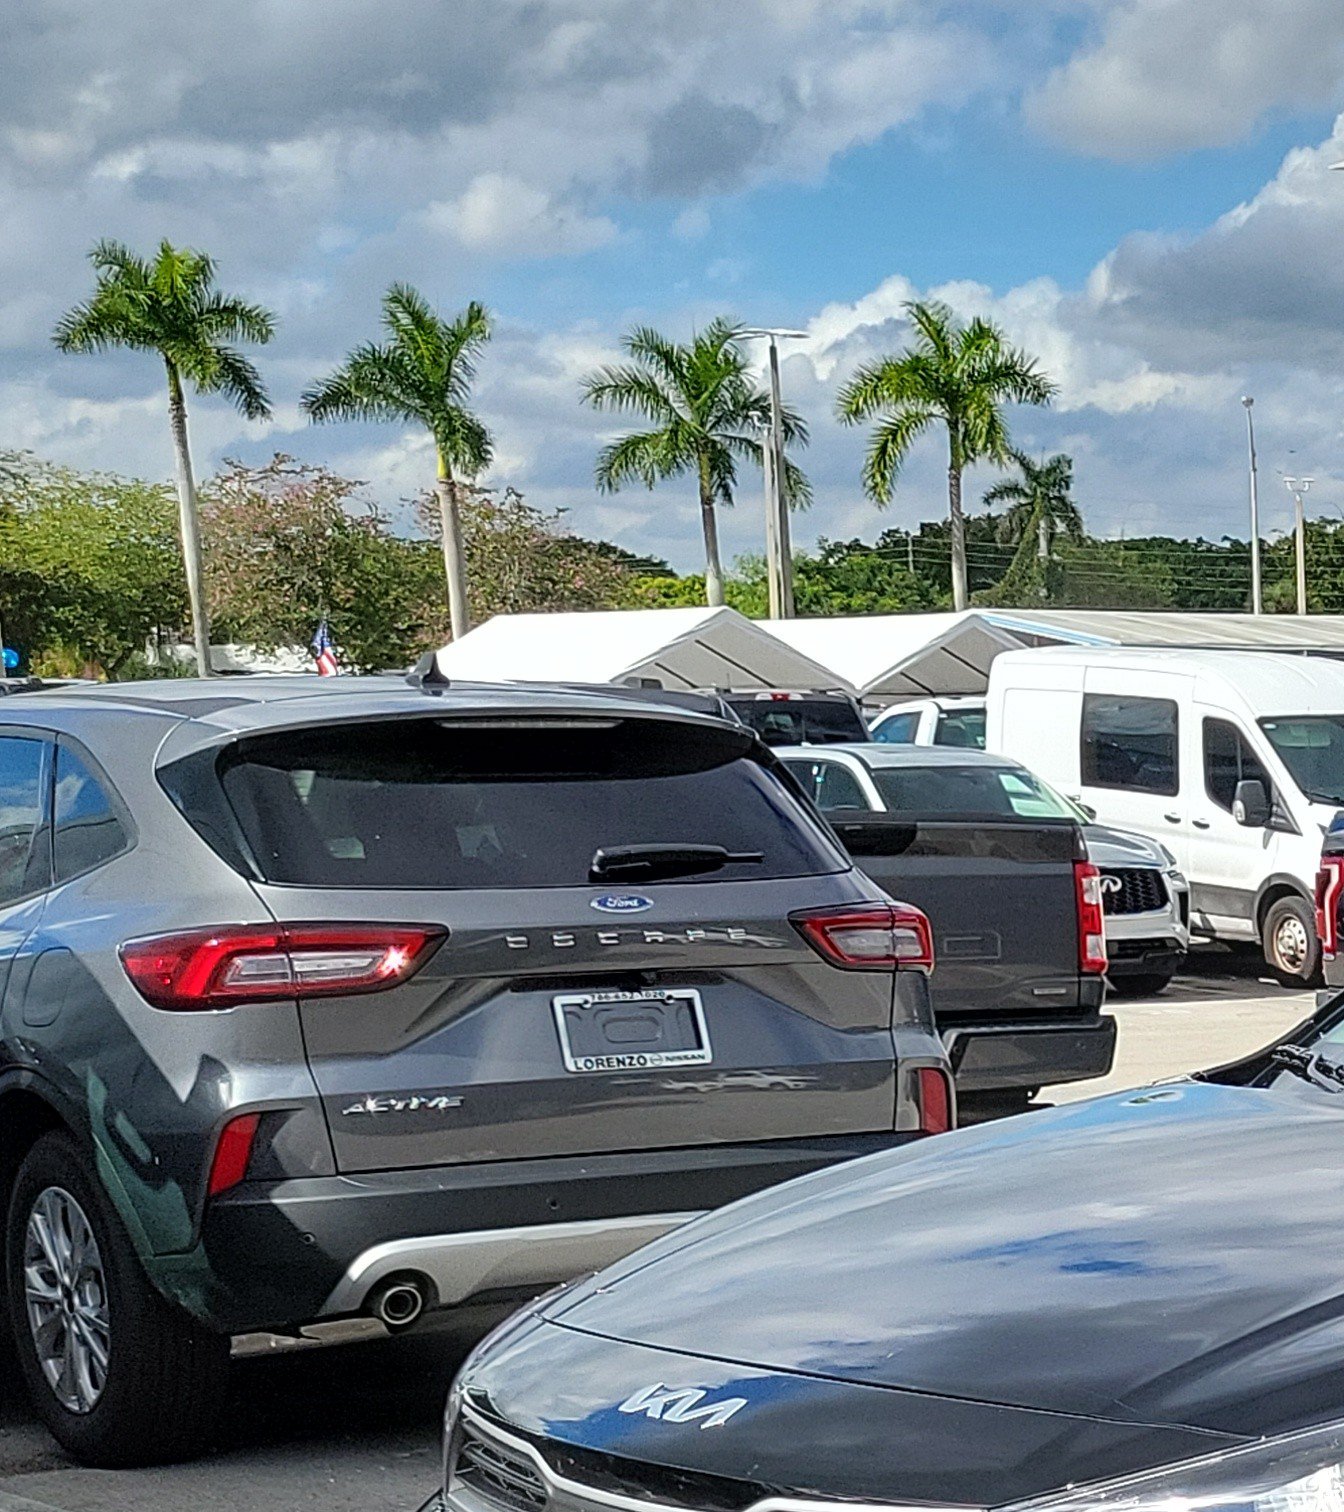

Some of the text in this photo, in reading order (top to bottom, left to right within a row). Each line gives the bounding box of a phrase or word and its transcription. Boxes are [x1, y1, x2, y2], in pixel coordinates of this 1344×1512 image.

[607, 896, 639, 908] Ford
[505, 927, 746, 949] ESCAPE
[574, 1055, 648, 1070] LORENZO
[342, 1096, 464, 1115] ACTIVE
